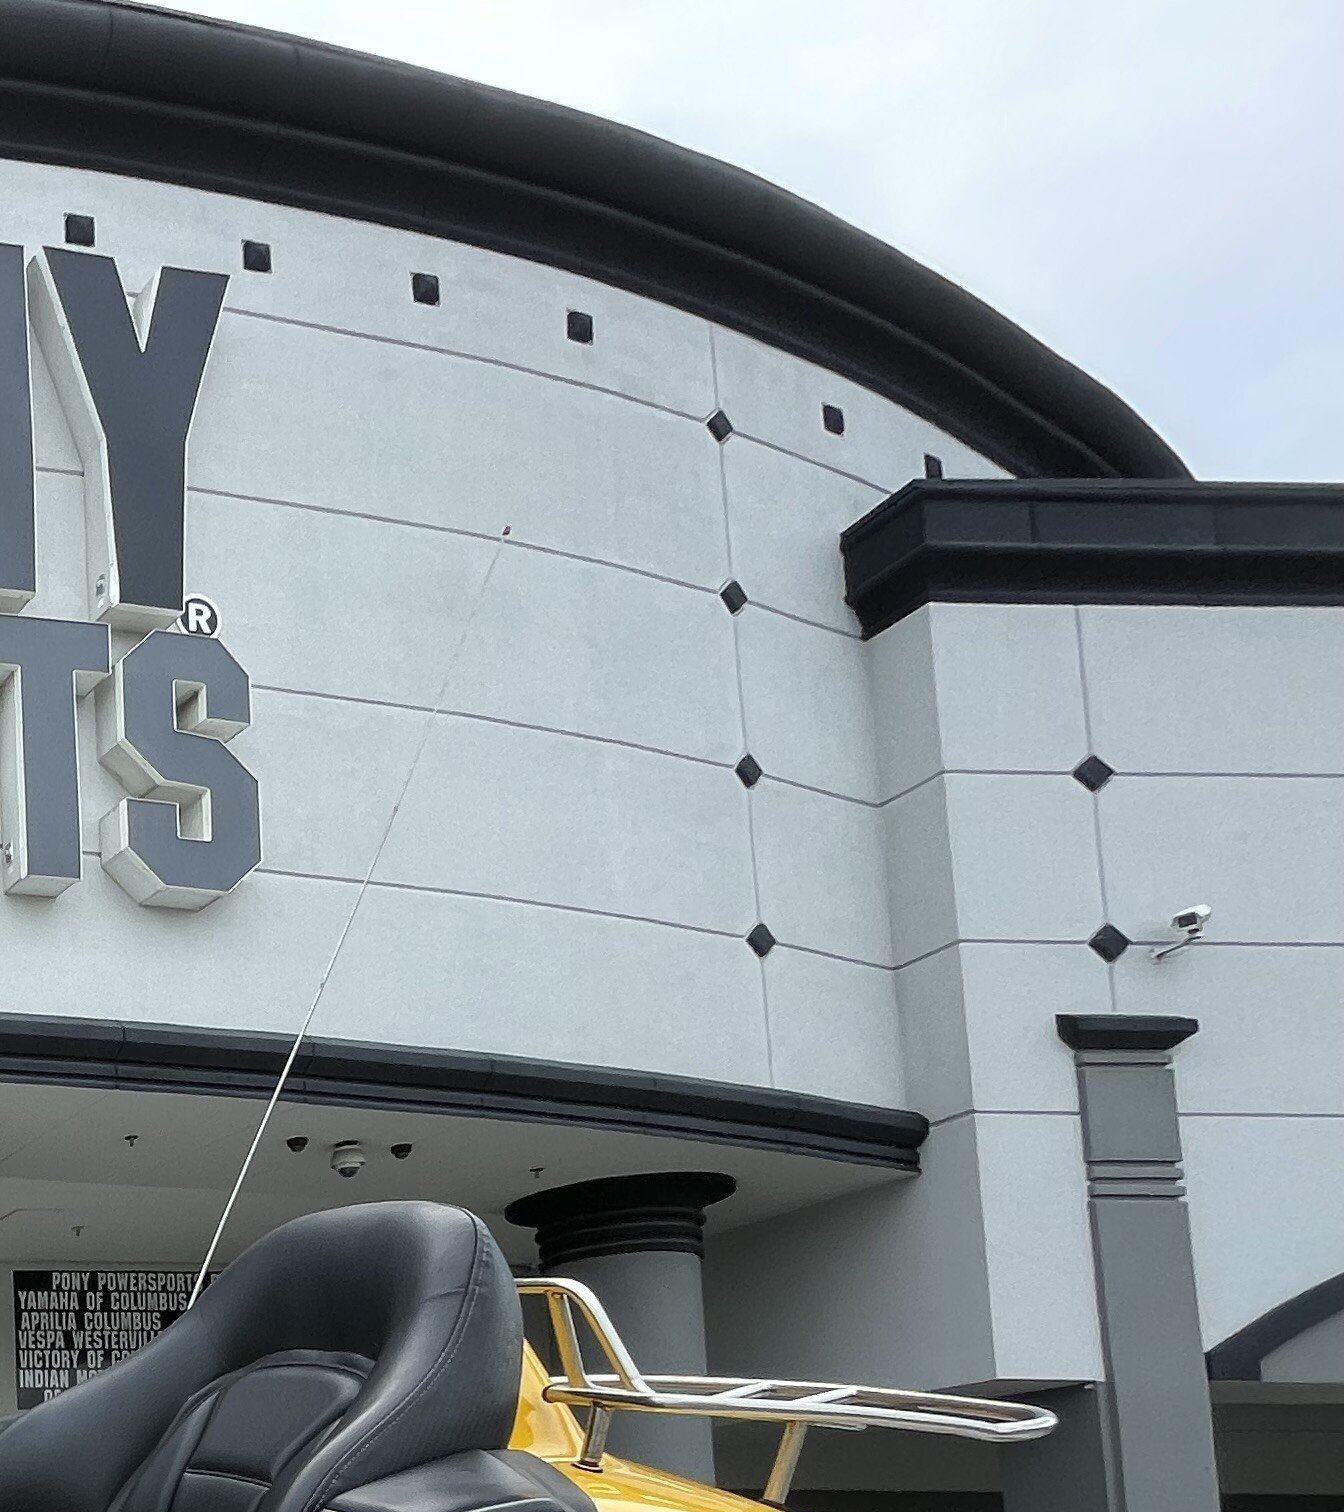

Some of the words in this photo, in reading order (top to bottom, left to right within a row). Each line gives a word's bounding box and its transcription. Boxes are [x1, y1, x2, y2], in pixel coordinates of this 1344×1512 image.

[52, 1272, 90, 1291] PONY
[18, 1291, 79, 1310] YAMAHA
[86, 1291, 103, 1310] OF
[110, 1292, 188, 1311] COLUMBUS
[21, 1312, 77, 1330] APRILIA
[84, 1312, 161, 1330] COLUMBUS
[18, 1330, 65, 1349] VESPA
[73, 1331, 163, 1350] WESTERVIL
[18, 1350, 79, 1368] VICTORY
[87, 1350, 104, 1368] OF
[19, 1369, 69, 1388] INDIAN
